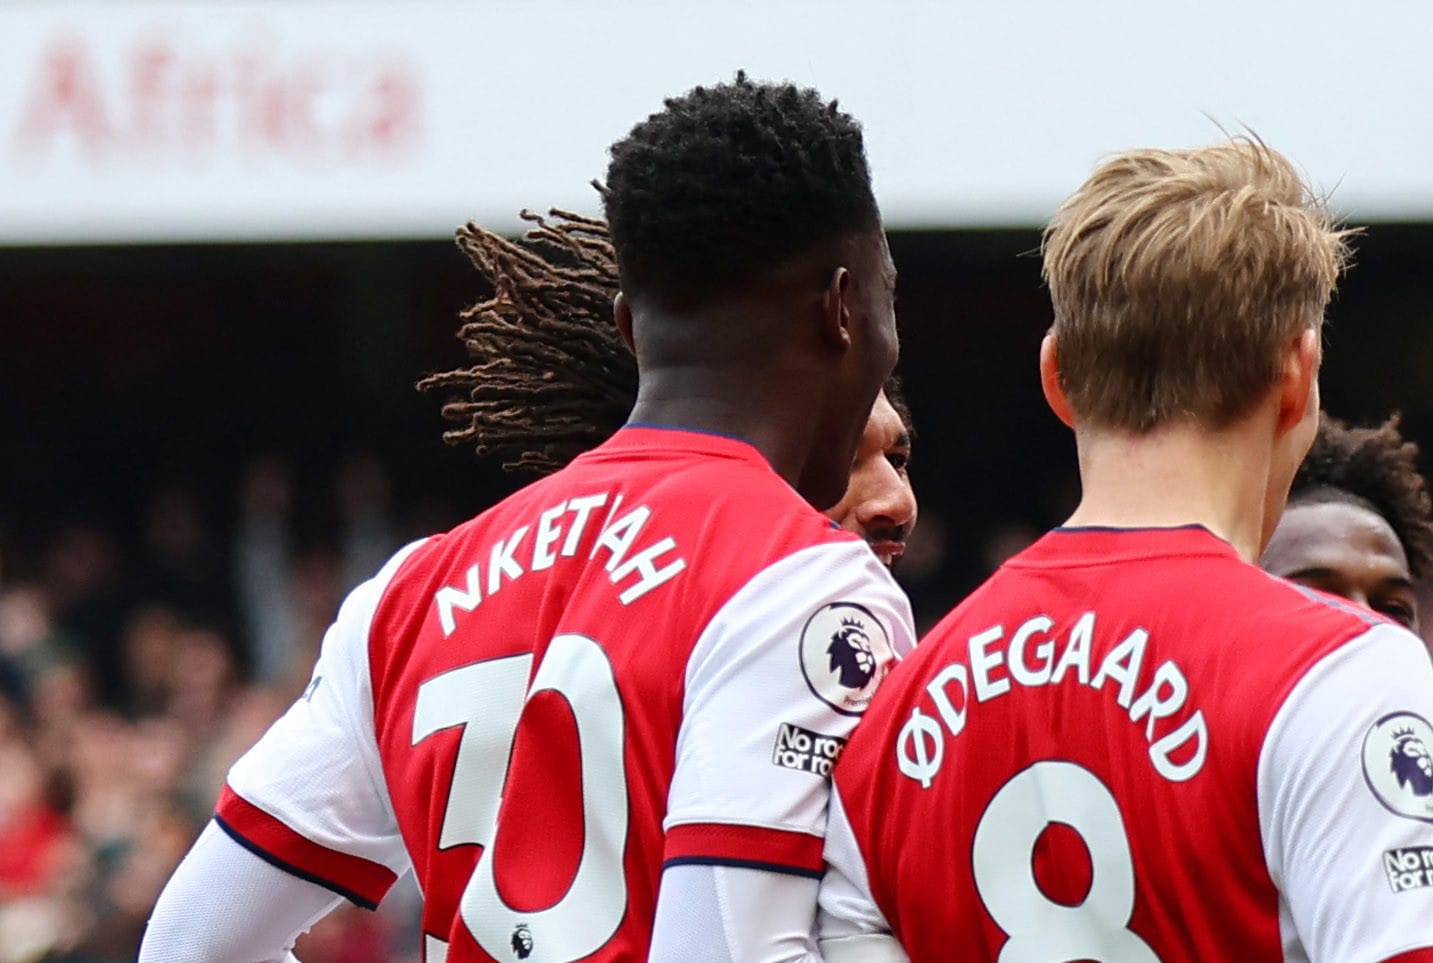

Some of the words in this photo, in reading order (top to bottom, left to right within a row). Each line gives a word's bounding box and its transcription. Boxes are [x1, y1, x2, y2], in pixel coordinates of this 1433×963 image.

[896, 611, 1208, 789] ØDEGAARD
[778, 724, 811, 751] No
[774, 746, 809, 769] for
[1383, 849, 1420, 872] No
[1389, 868, 1423, 893] for
